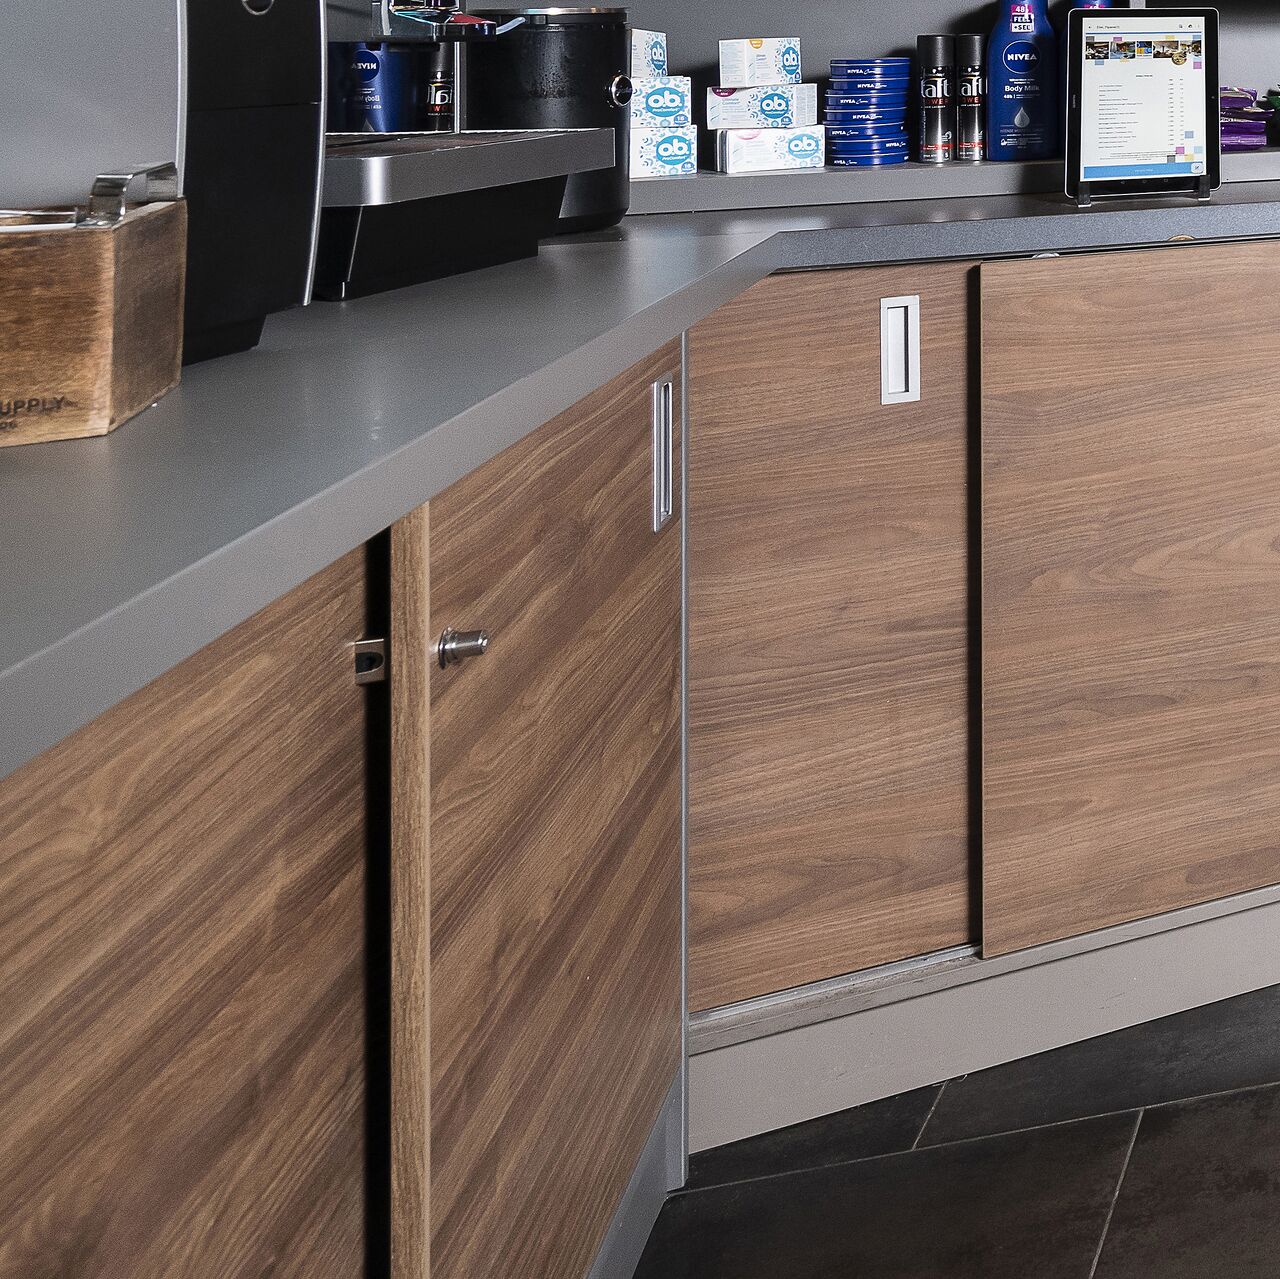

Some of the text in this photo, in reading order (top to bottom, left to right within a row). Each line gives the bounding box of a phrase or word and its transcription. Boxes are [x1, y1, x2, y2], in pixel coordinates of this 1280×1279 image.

[1007, 53, 1038, 61] NIVEA
[1005, 85, 1023, 93] Body
[0, 395, 66, 417] UPPLY
